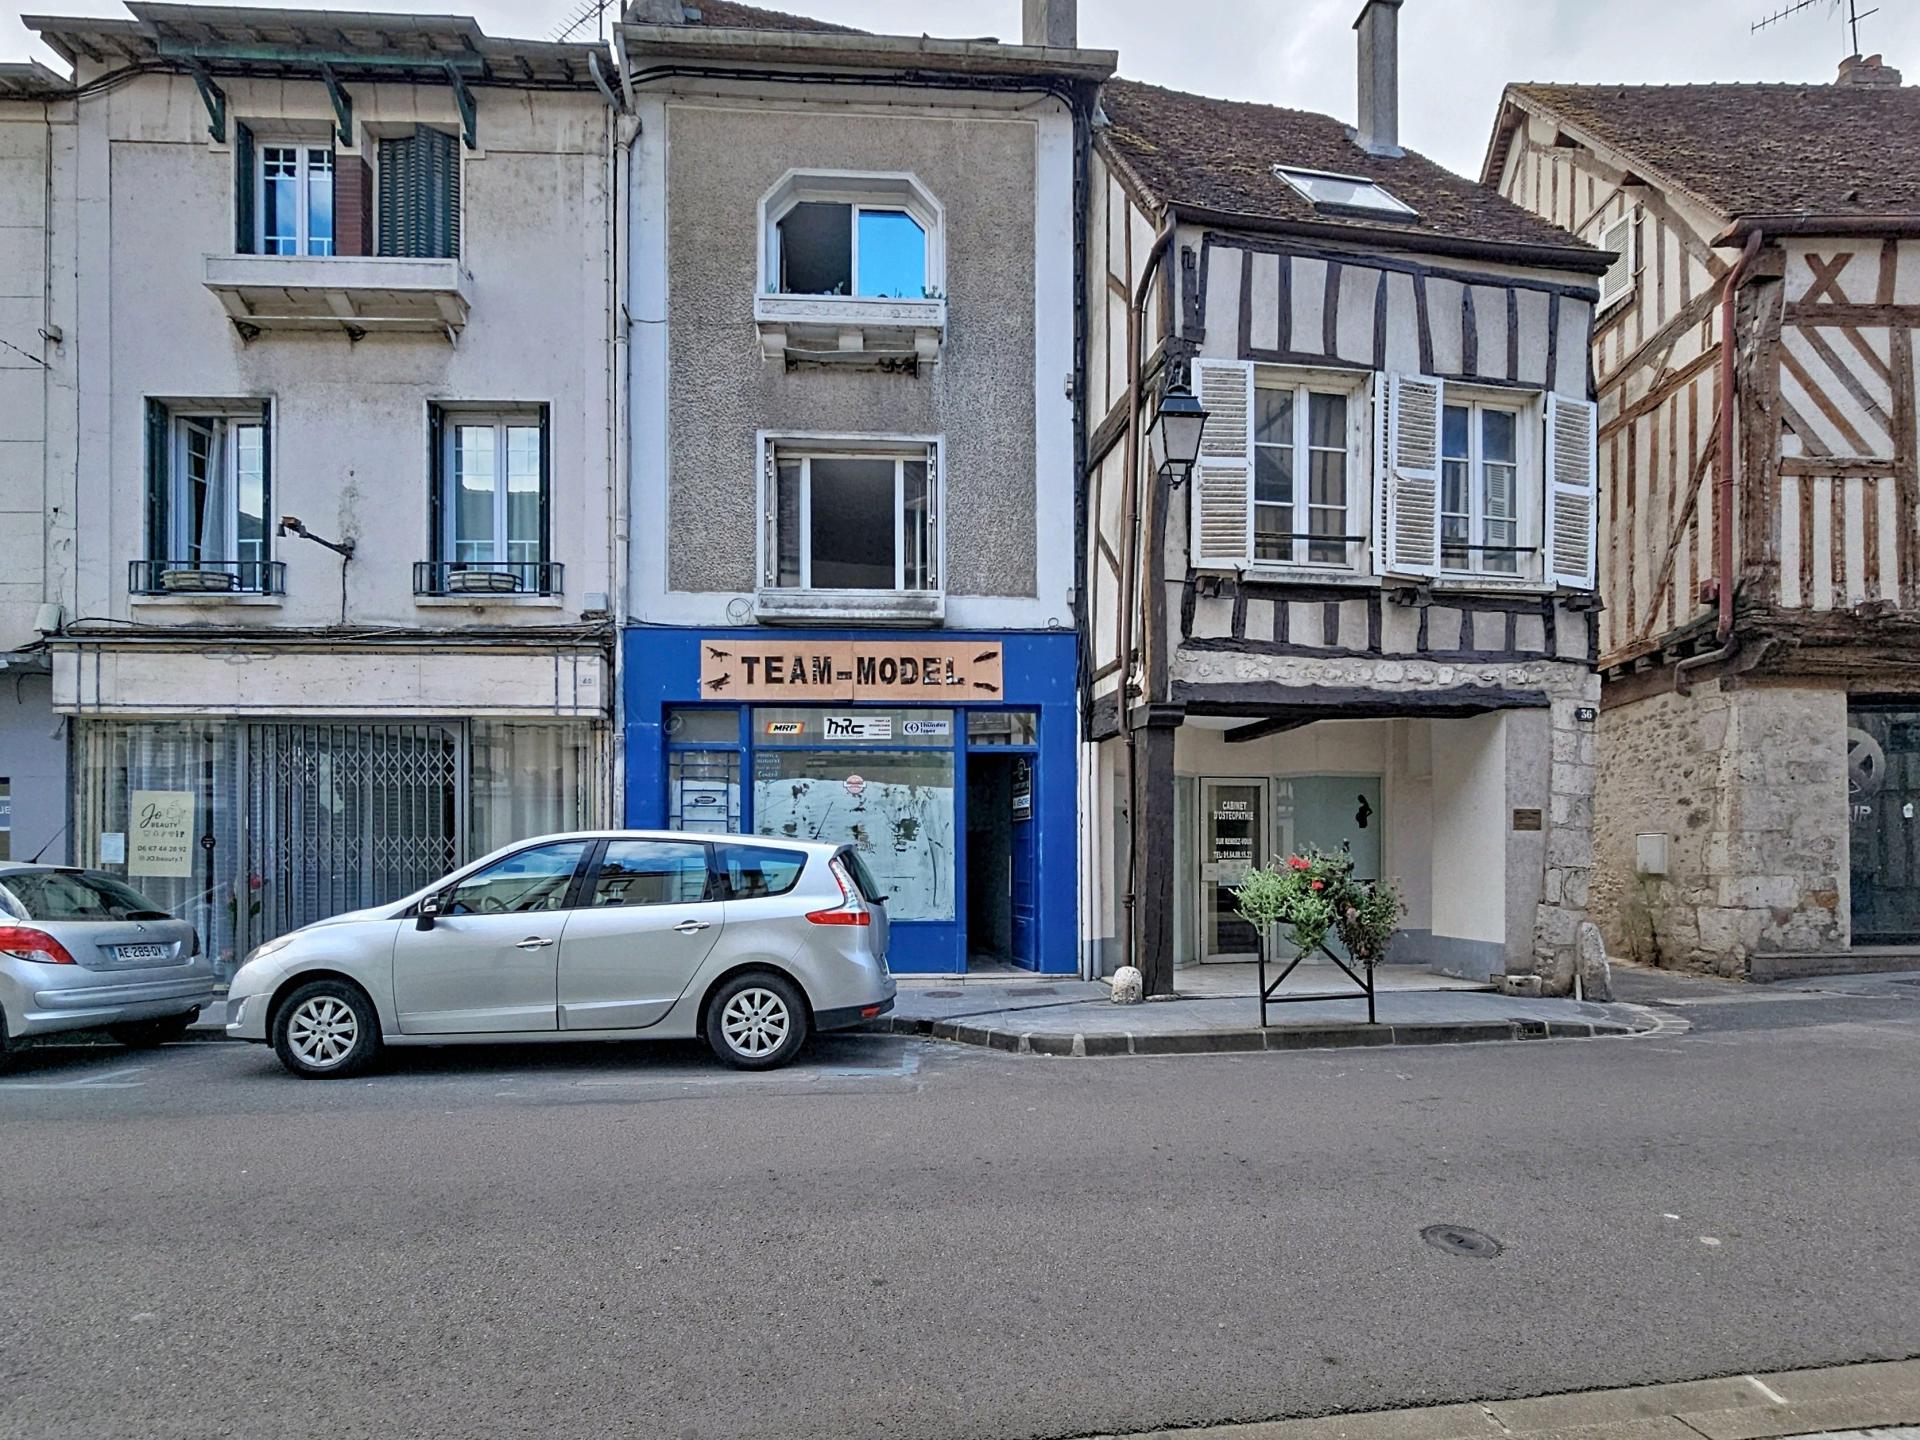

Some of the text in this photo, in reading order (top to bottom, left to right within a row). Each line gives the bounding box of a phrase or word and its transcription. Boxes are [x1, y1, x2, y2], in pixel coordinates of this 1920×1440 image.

[740, 655, 966, 686] TEAM-MODEL
[1581, 709, 1592, 719] 36
[773, 724, 797, 732] MRP
[1222, 801, 1247, 810] CABINET
[139, 802, 162, 828] Jo
[1213, 811, 1254, 820] D'OSTEOPATHIE
